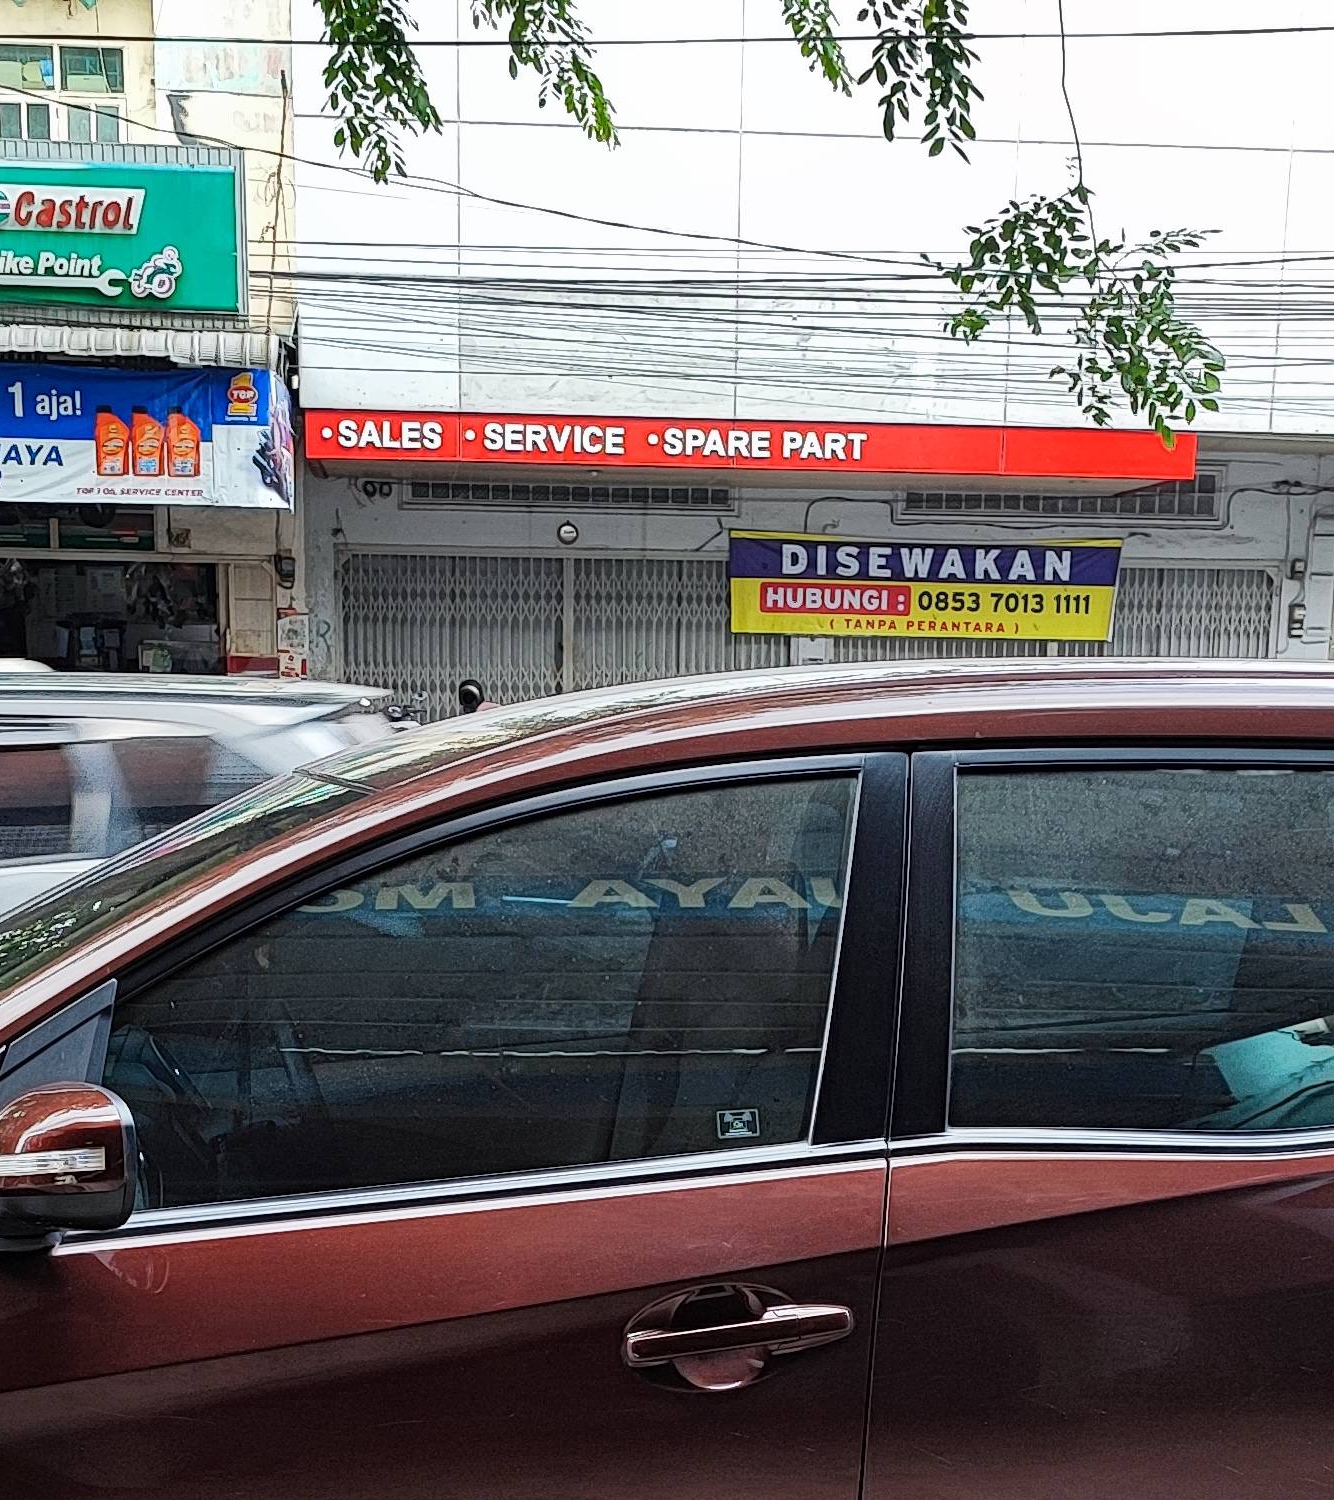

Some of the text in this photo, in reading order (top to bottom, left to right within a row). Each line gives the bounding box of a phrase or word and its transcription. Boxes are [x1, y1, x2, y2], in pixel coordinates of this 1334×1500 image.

[14, 191, 134, 230] Castrol
[37, 251, 101, 276] Point
[7, 381, 24, 418] 1
[35, 389, 83, 421] aja!
[337, 420, 868, 461] SALES SERVICE SPARE PART
[119, 487, 161, 497] SERVICE
[164, 488, 204, 497] CENTER
[781, 543, 1072, 582] DISEWAKAN
[766, 586, 889, 611] HUBUNGI
[918, 590, 980, 613] 0853
[990, 592, 1044, 614] 7013
[1054, 594, 1091, 615] 1111
[844, 618, 897, 631] TANPA
[906, 619, 1006, 633] PERANTARA
